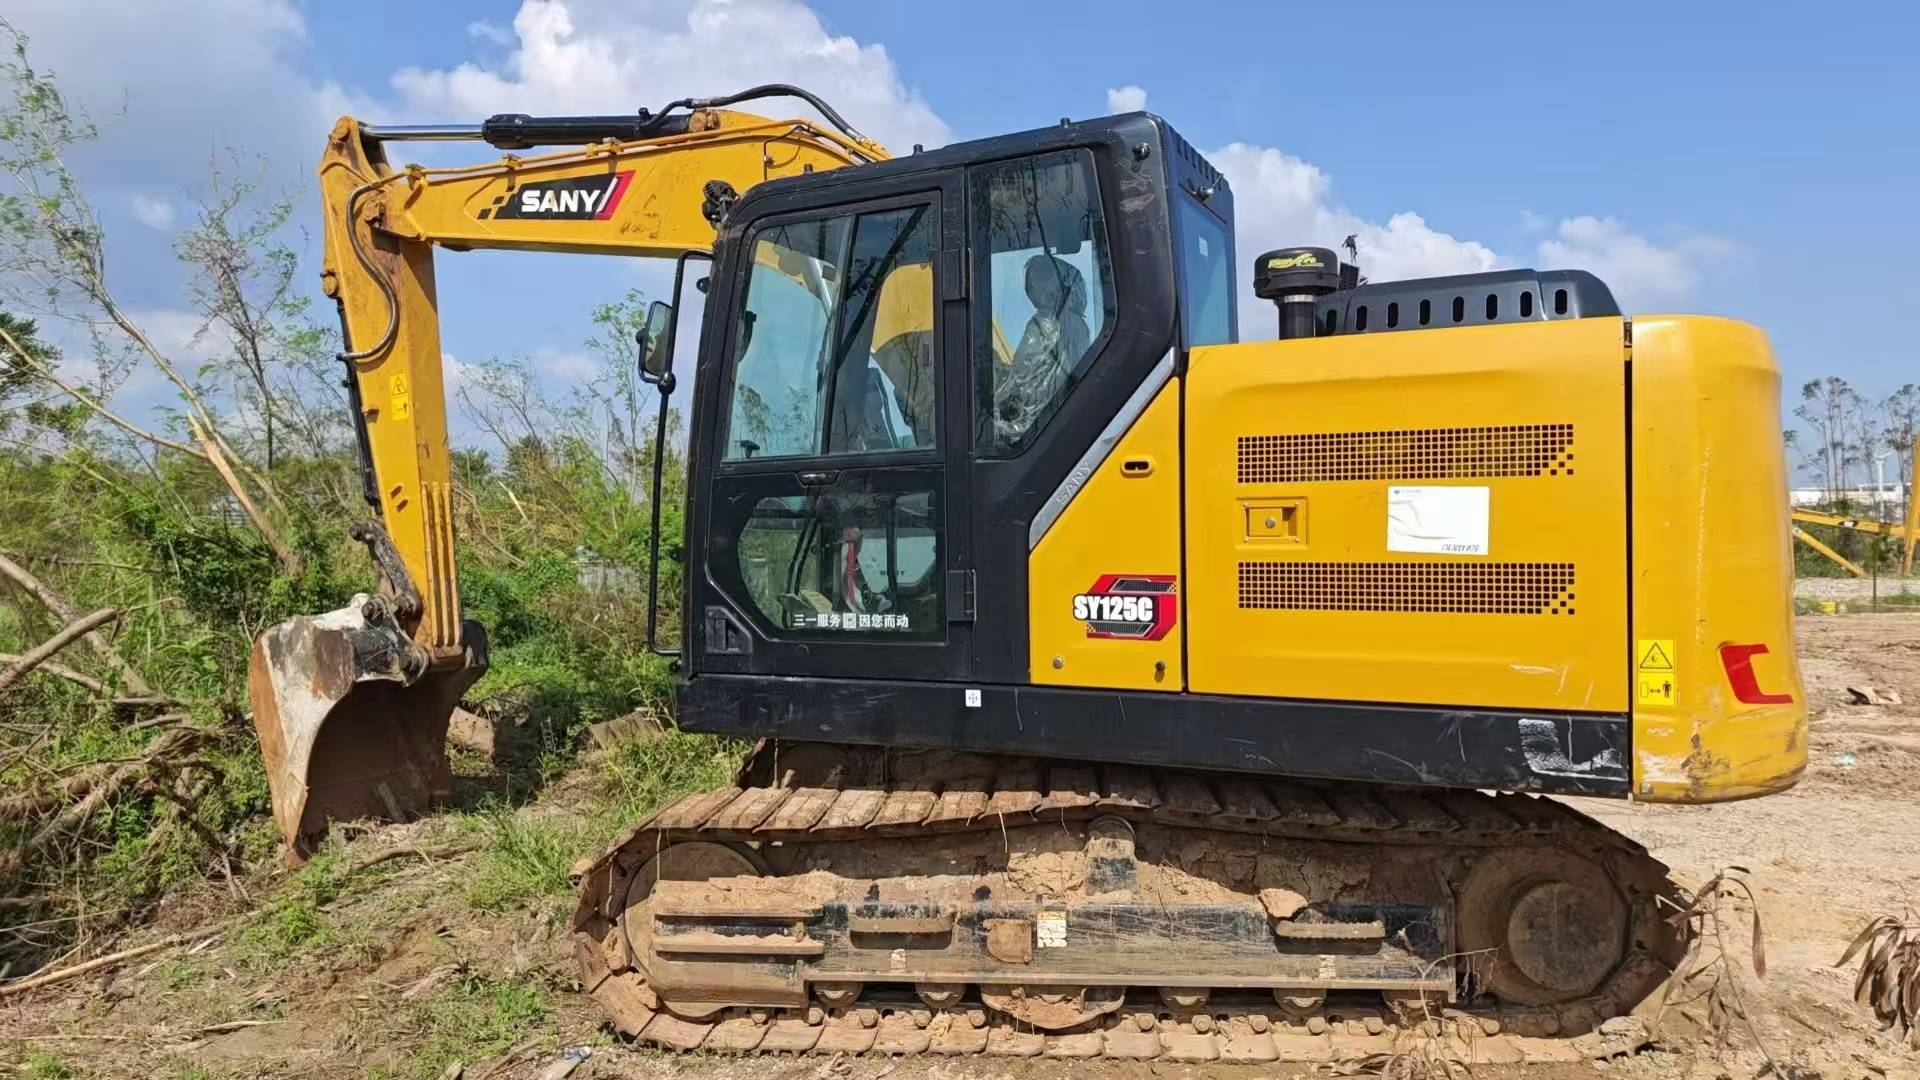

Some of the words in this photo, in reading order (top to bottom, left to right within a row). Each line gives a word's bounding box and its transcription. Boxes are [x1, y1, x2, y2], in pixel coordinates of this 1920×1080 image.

[521, 189, 602, 213] SANY
[1055, 461, 1093, 506] SANY
[1073, 595, 1153, 621] SY125C
[793, 614, 840, 628] 三一服务
[859, 614, 909, 628] 因您而动
